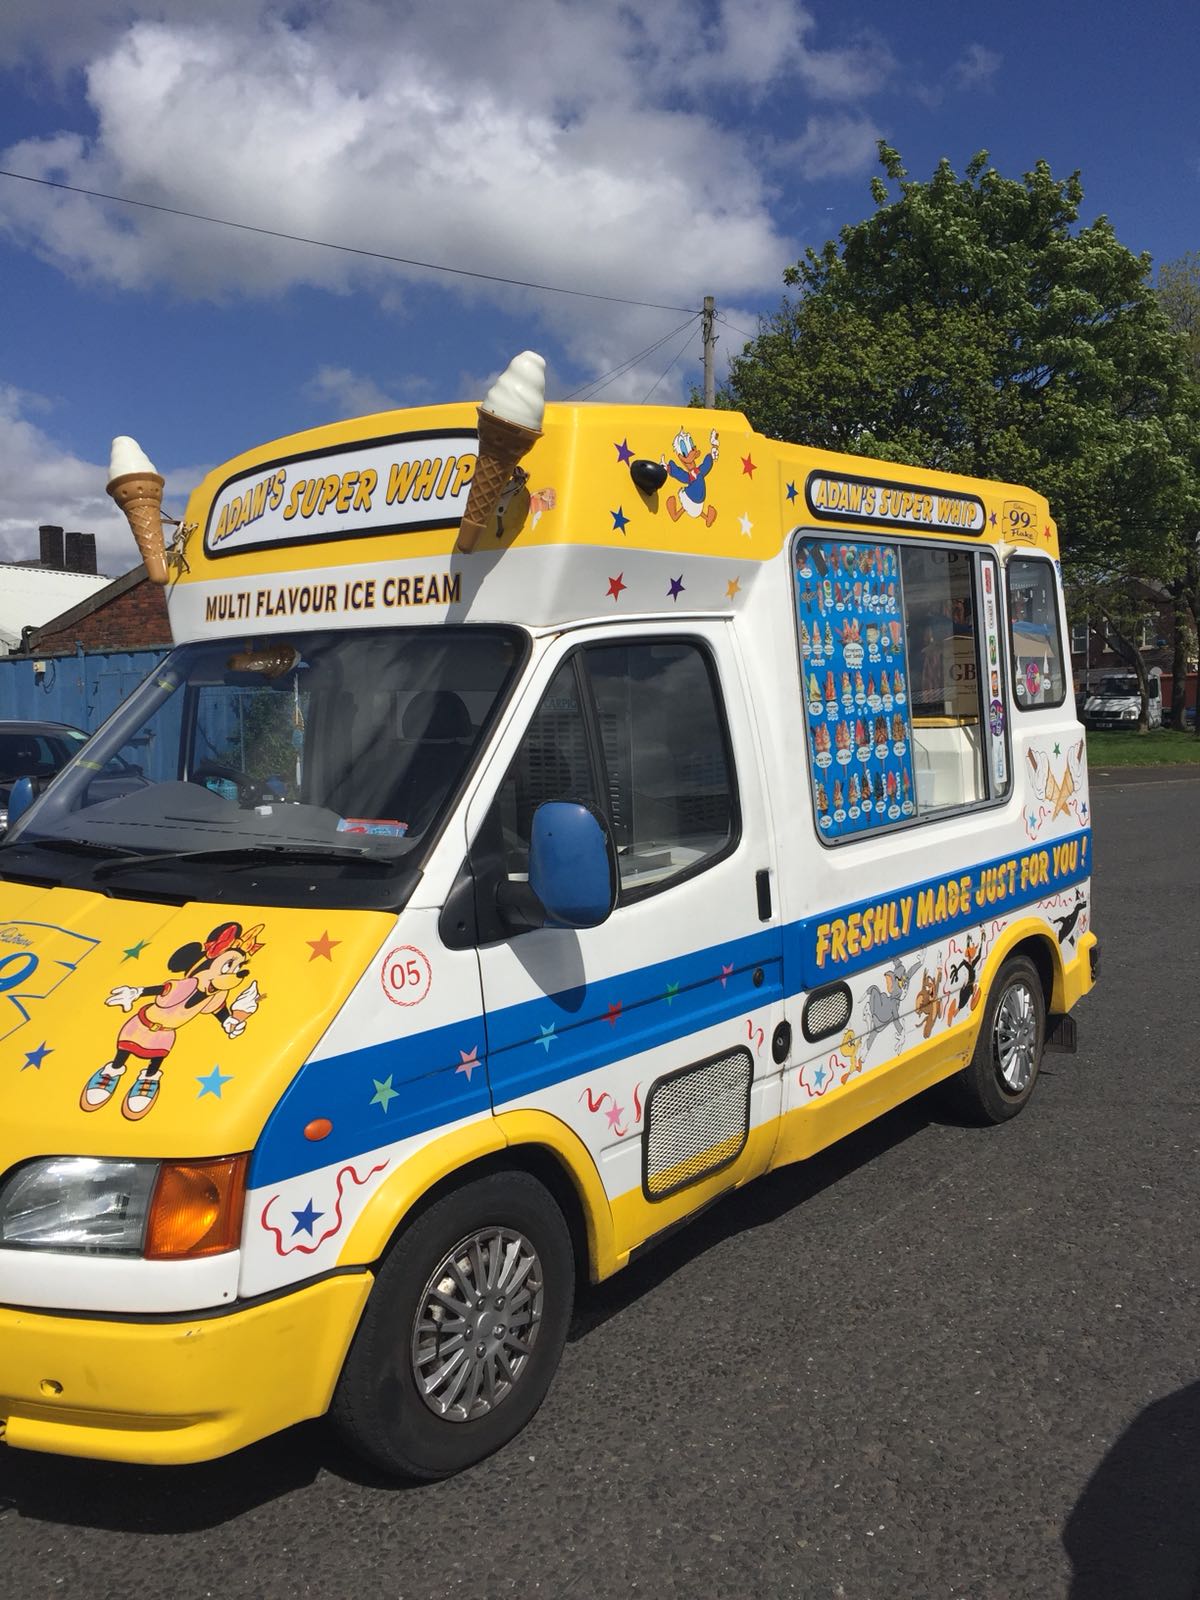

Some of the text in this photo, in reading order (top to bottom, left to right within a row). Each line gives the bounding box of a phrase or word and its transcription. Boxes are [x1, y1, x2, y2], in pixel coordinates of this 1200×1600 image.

[213, 453, 478, 545] ADAM'S SUPER WHIP
[816, 479, 977, 527] ADAM'S SUPER WHIP
[1009, 510, 1031, 528] 99
[205, 572, 463, 623] MULTI FLAVOUR ICE CREAM
[815, 896, 913, 968] FRESHLY
[916, 875, 971, 928] MADE
[975, 860, 1017, 904] JUST
[1020, 849, 1050, 887] FOR
[1053, 841, 1078, 879] YOU
[390, 960, 420, 990] 05
